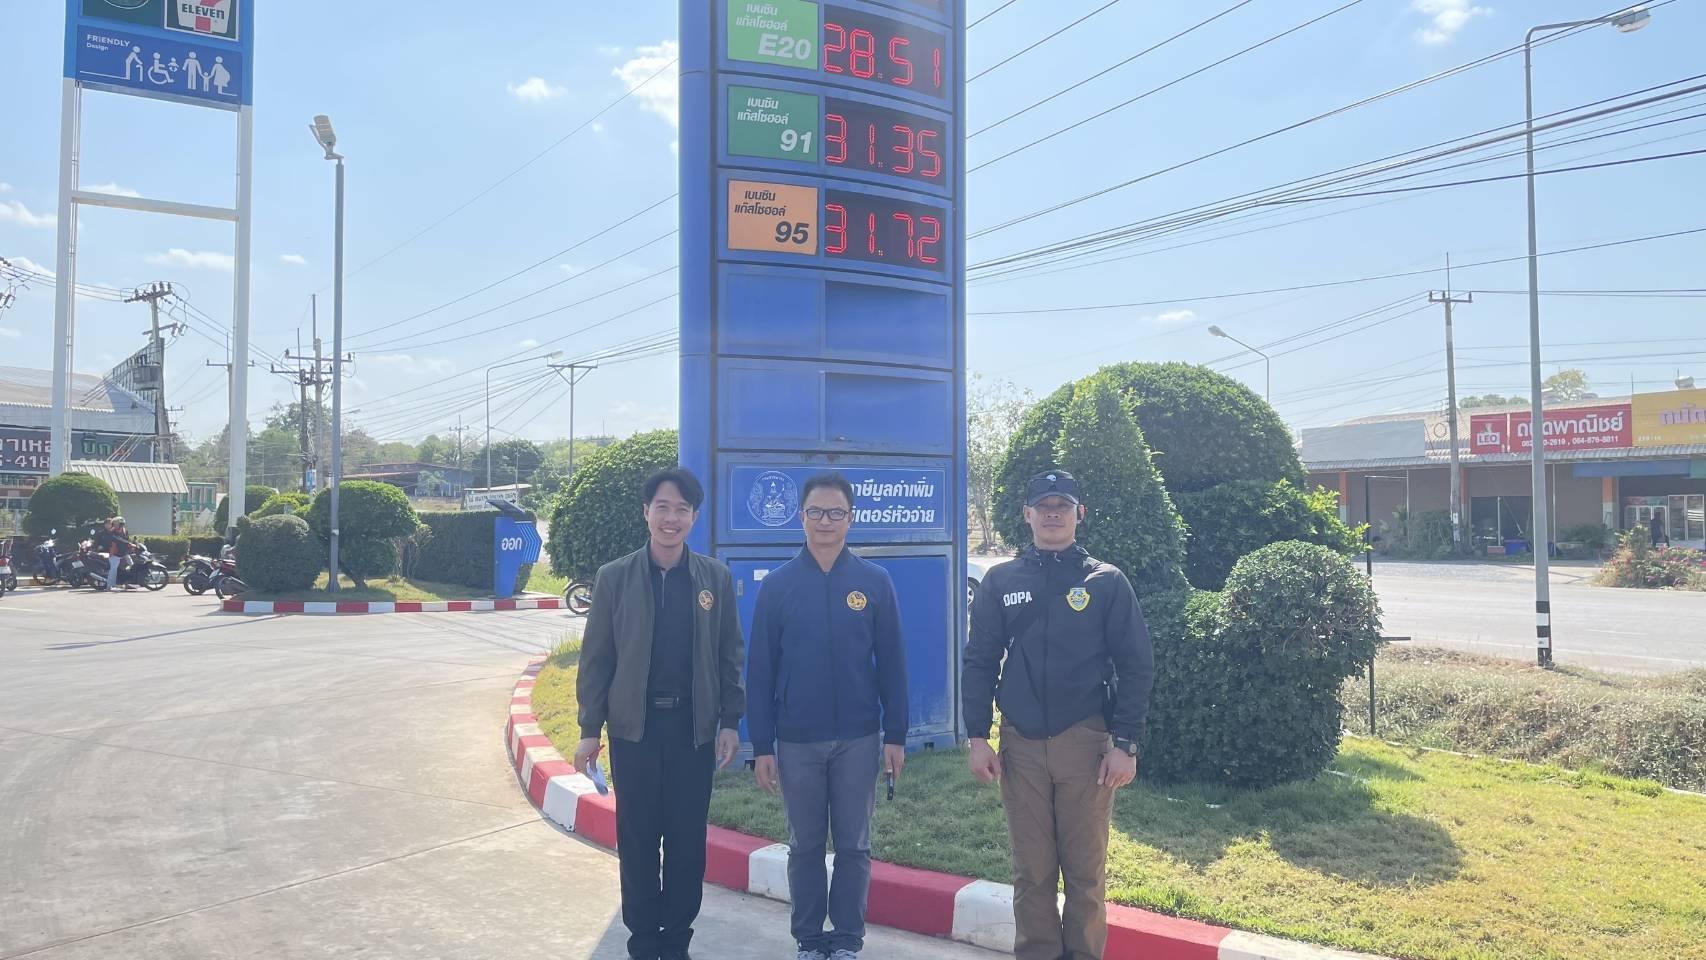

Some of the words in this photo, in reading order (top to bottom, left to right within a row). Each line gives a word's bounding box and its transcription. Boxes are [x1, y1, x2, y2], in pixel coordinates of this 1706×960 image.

[745, 3, 778, 16] เบนซิน
[86, 34, 130, 47] FRIENDLY
[86, 42, 109, 51] Design
[758, 32, 812, 60] E20
[823, 23, 941, 88] 28.51
[747, 97, 779, 110] เบนซิน
[780, 129, 812, 154] 91
[824, 113, 941, 178] 31.35
[744, 189, 776, 202] เบนซิน
[774, 221, 810, 245] 95
[824, 203, 941, 264] 31.72
[1479, 434, 1498, 444] LEO
[851, 504, 935, 523] เตอร์หัวจ่าย
[501, 537, 522, 551] ออก
[1003, 591, 1032, 607] DOPA
